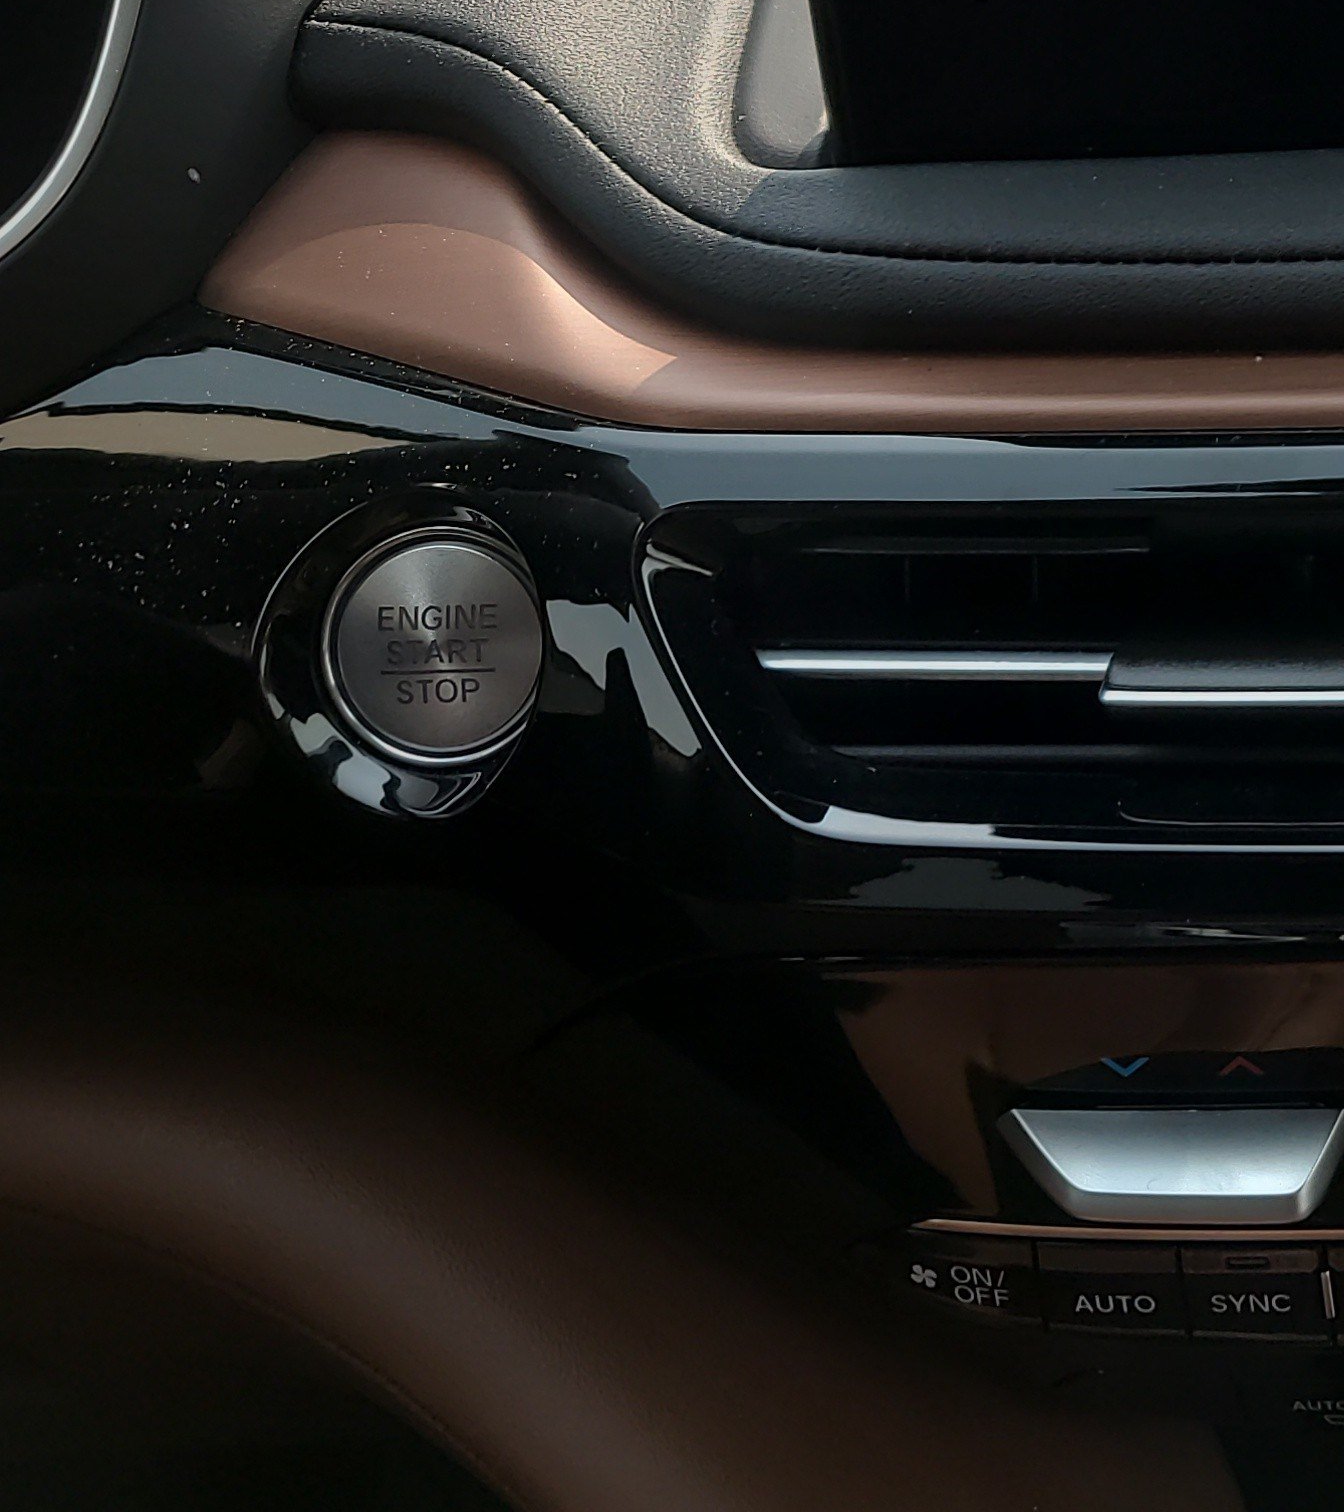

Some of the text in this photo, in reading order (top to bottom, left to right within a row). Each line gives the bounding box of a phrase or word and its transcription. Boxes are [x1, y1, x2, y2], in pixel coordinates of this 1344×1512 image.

[377, 604, 497, 631] ENGINE
[387, 639, 488, 664] START
[396, 678, 480, 705] STOP
[955, 1285, 1008, 1306] OFF
[1076, 1295, 1155, 1313] AUTO
[1212, 1295, 1290, 1312] SYNC
